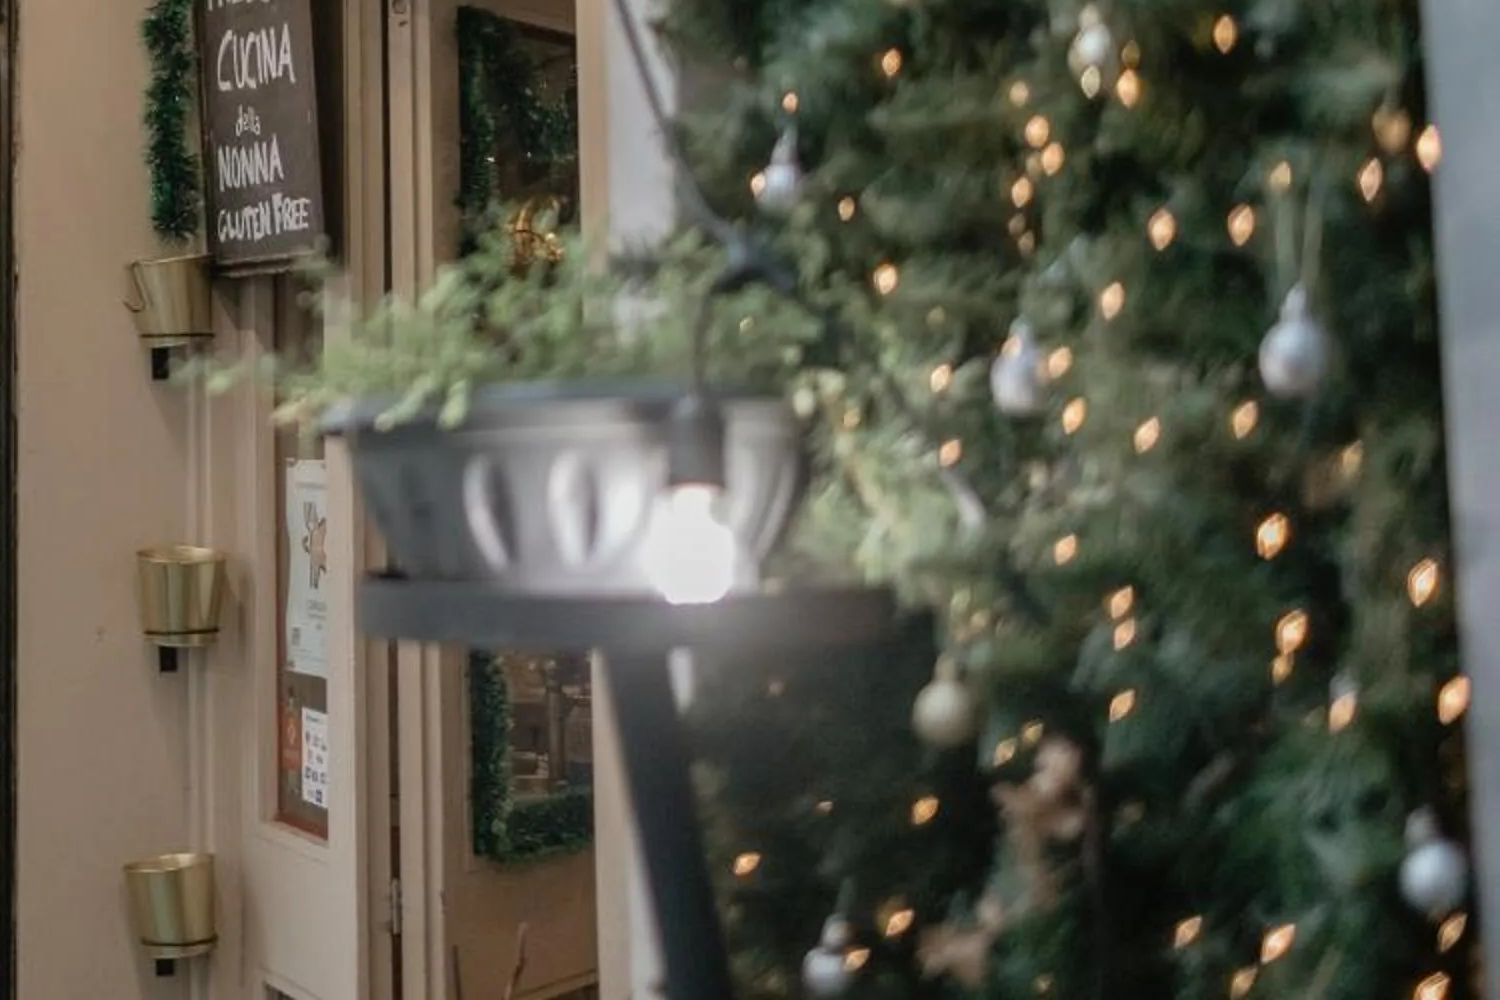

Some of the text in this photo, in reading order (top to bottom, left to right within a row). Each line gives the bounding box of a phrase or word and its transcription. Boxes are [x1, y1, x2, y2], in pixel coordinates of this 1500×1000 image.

[217, 23, 296, 91] CUCINA
[218, 134, 285, 192] NONNA
[218, 192, 311, 242] GLUTEN FREE
